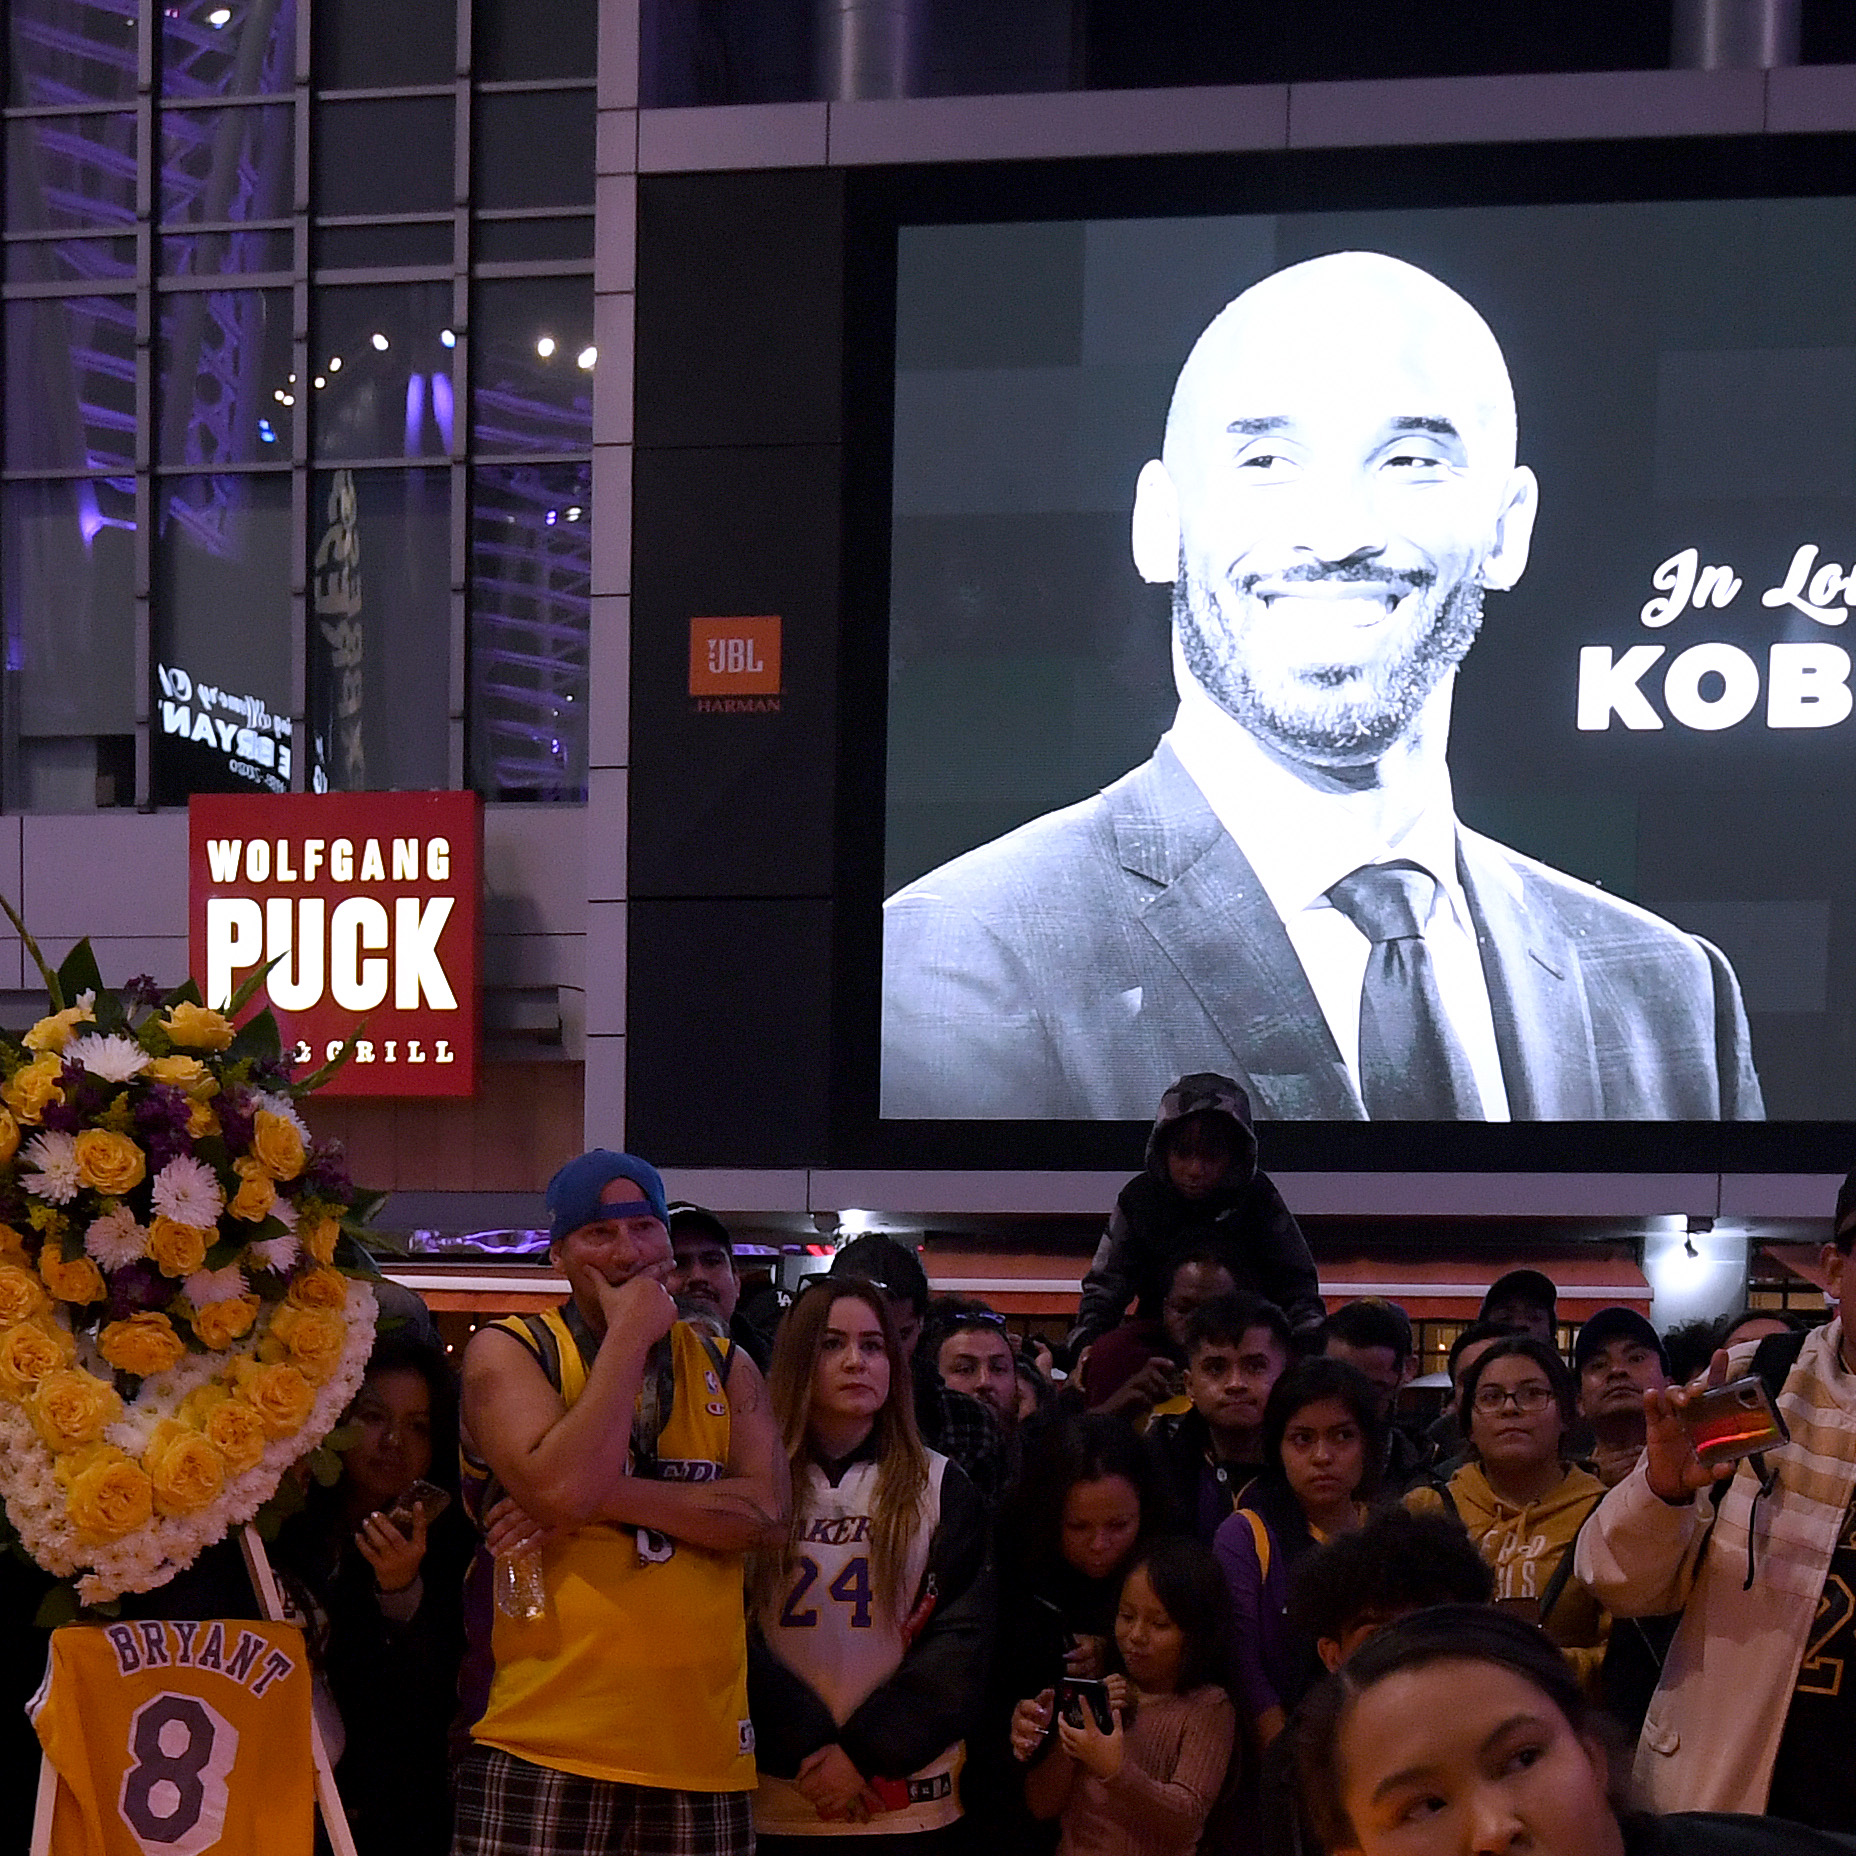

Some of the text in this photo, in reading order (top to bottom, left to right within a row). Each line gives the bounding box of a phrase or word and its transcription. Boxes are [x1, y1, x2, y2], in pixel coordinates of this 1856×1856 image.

[1640, 547, 1743, 630] In
[707, 638, 764, 674] JBL
[697, 699, 781, 713] HARMAN
[206, 836, 451, 883] WOLFGANG
[206, 896, 460, 1012] PUCK
[326, 1039, 455, 1064] GRILL
[779, 1556, 874, 1629] 24
[103, 1620, 295, 1699] BRYANT
